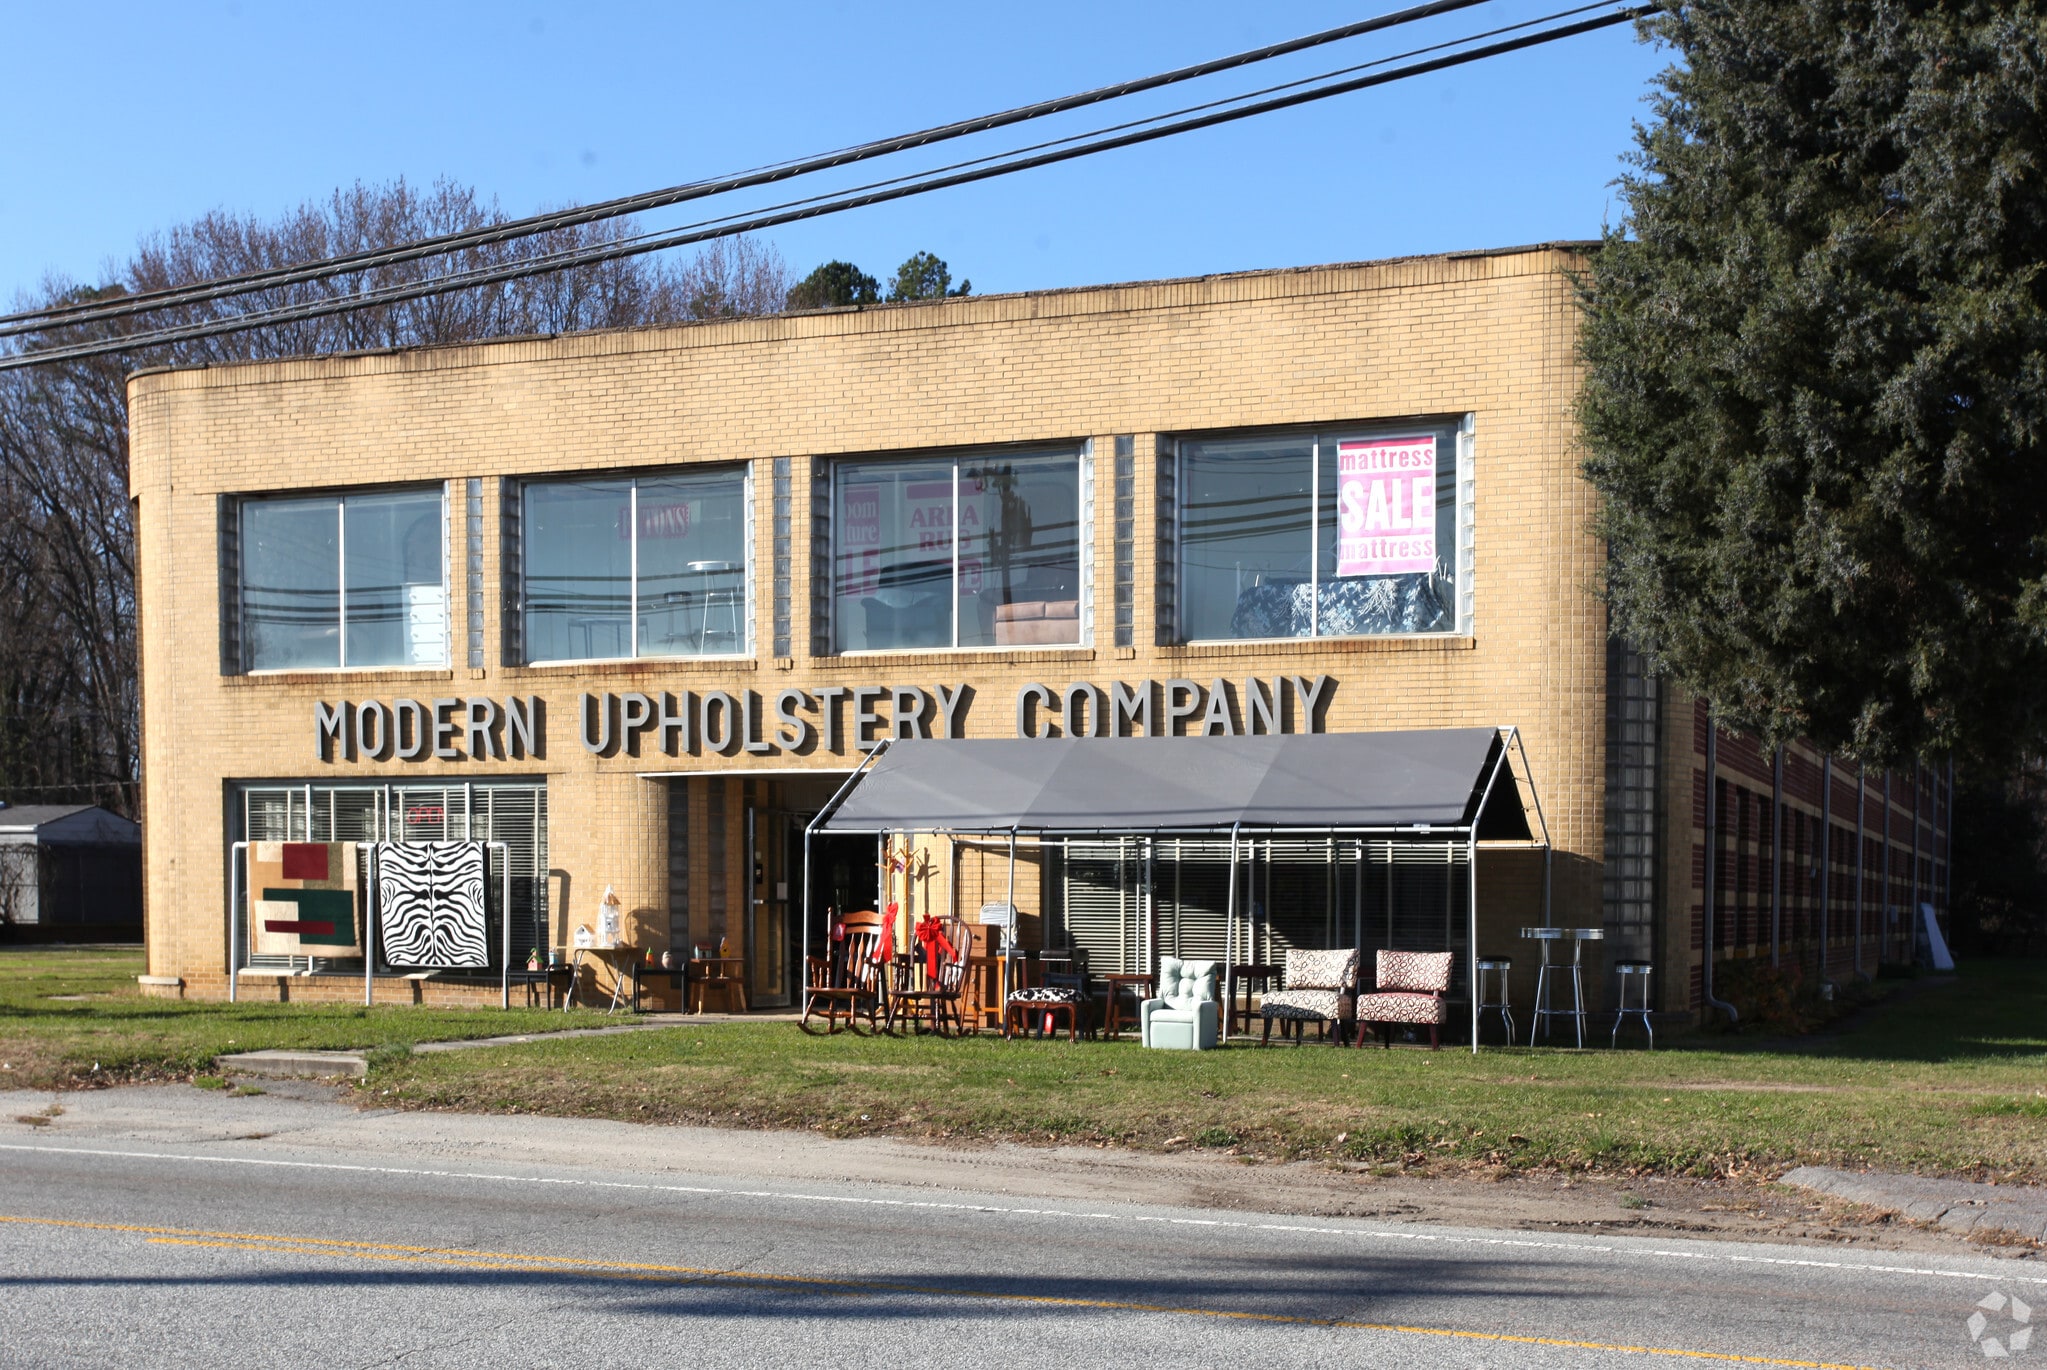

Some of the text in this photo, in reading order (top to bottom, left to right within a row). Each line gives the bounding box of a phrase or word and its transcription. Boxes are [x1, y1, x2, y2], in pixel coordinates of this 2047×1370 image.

[1340, 449, 1433, 472] mattress
[1341, 476, 1433, 533] SALE
[918, 529, 972, 553] RUG
[1340, 539, 1433, 561] mattress
[315, 674, 1328, 759] MODERN UPHOLSTERY COMPANY
